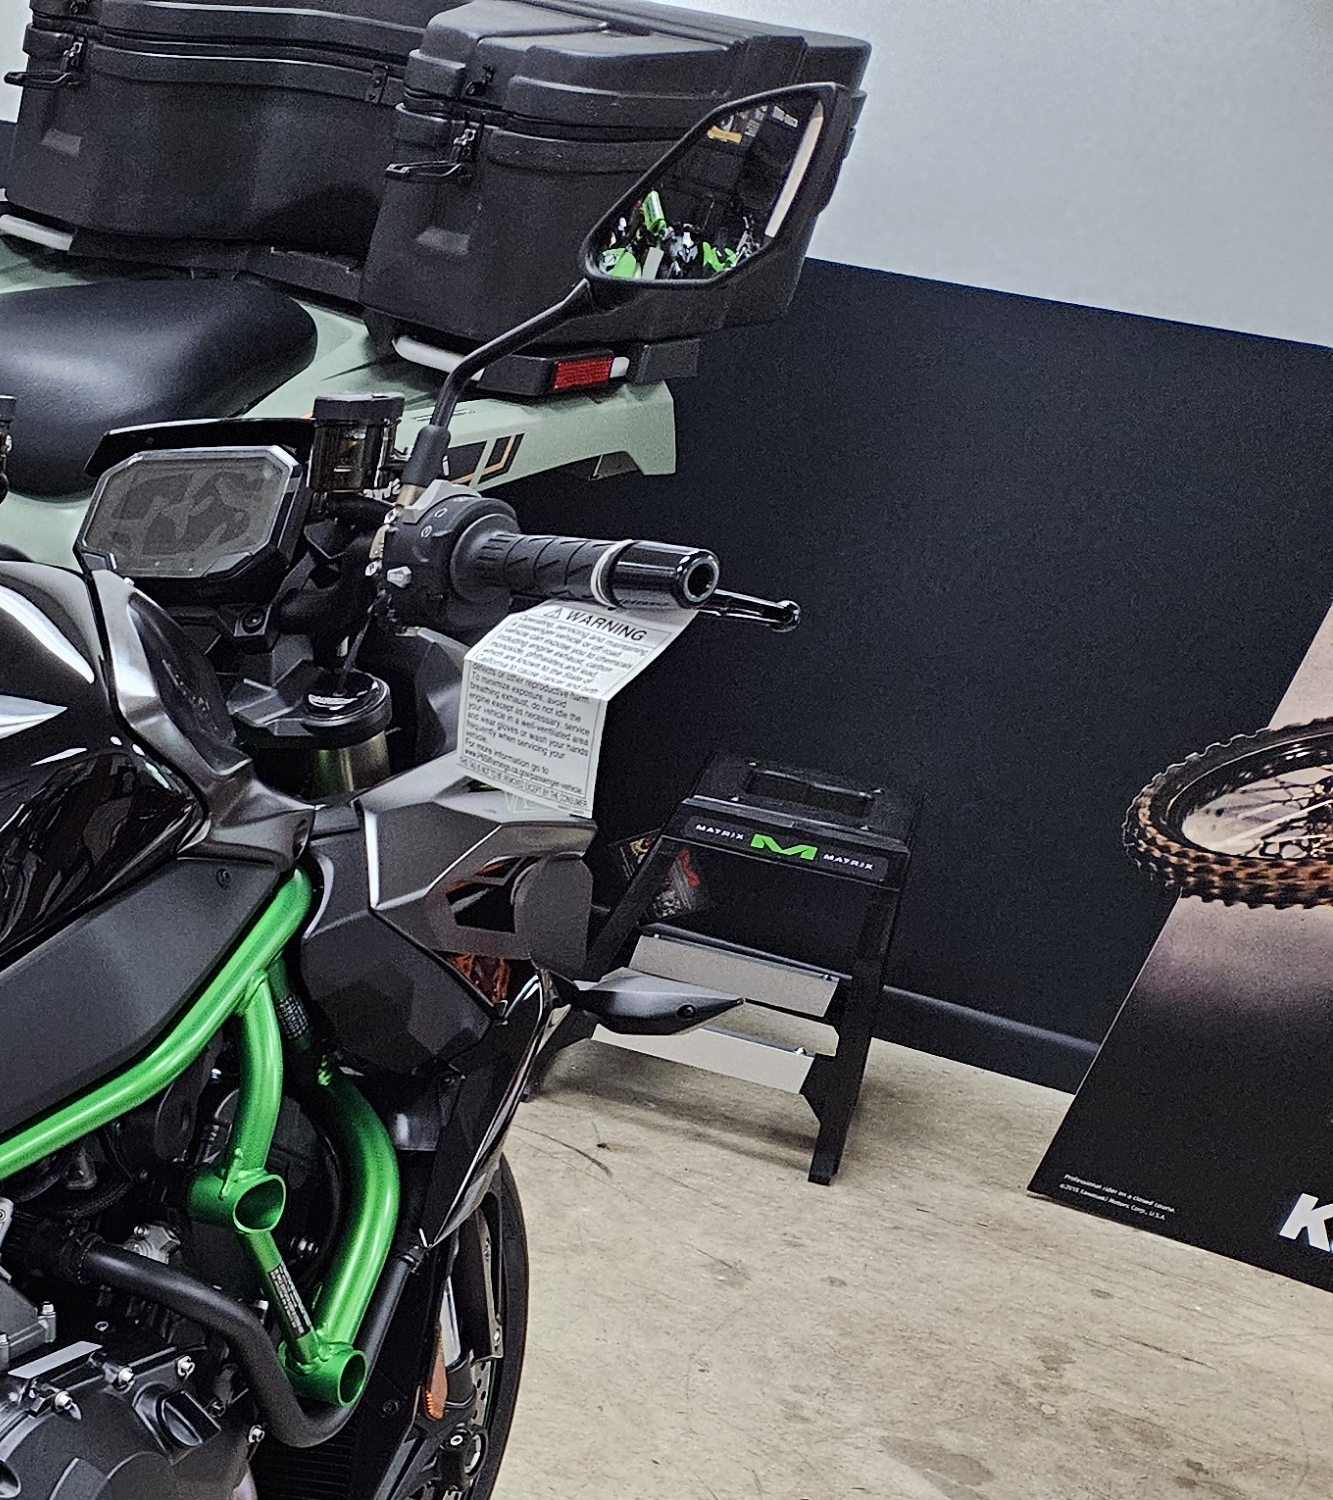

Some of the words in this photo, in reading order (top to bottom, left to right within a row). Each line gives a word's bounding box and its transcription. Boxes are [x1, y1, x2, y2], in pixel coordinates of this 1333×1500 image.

[565, 610, 648, 642] WARNING
[695, 823, 745, 841] MATRIX
[822, 852, 875, 871] MATRIX
[1079, 1188, 1109, 1202] Kawasaki
[1108, 1197, 1130, 1209] Motors
[1102, 1186, 1118, 1195] rider
[1132, 1196, 1155, 1206] closed
